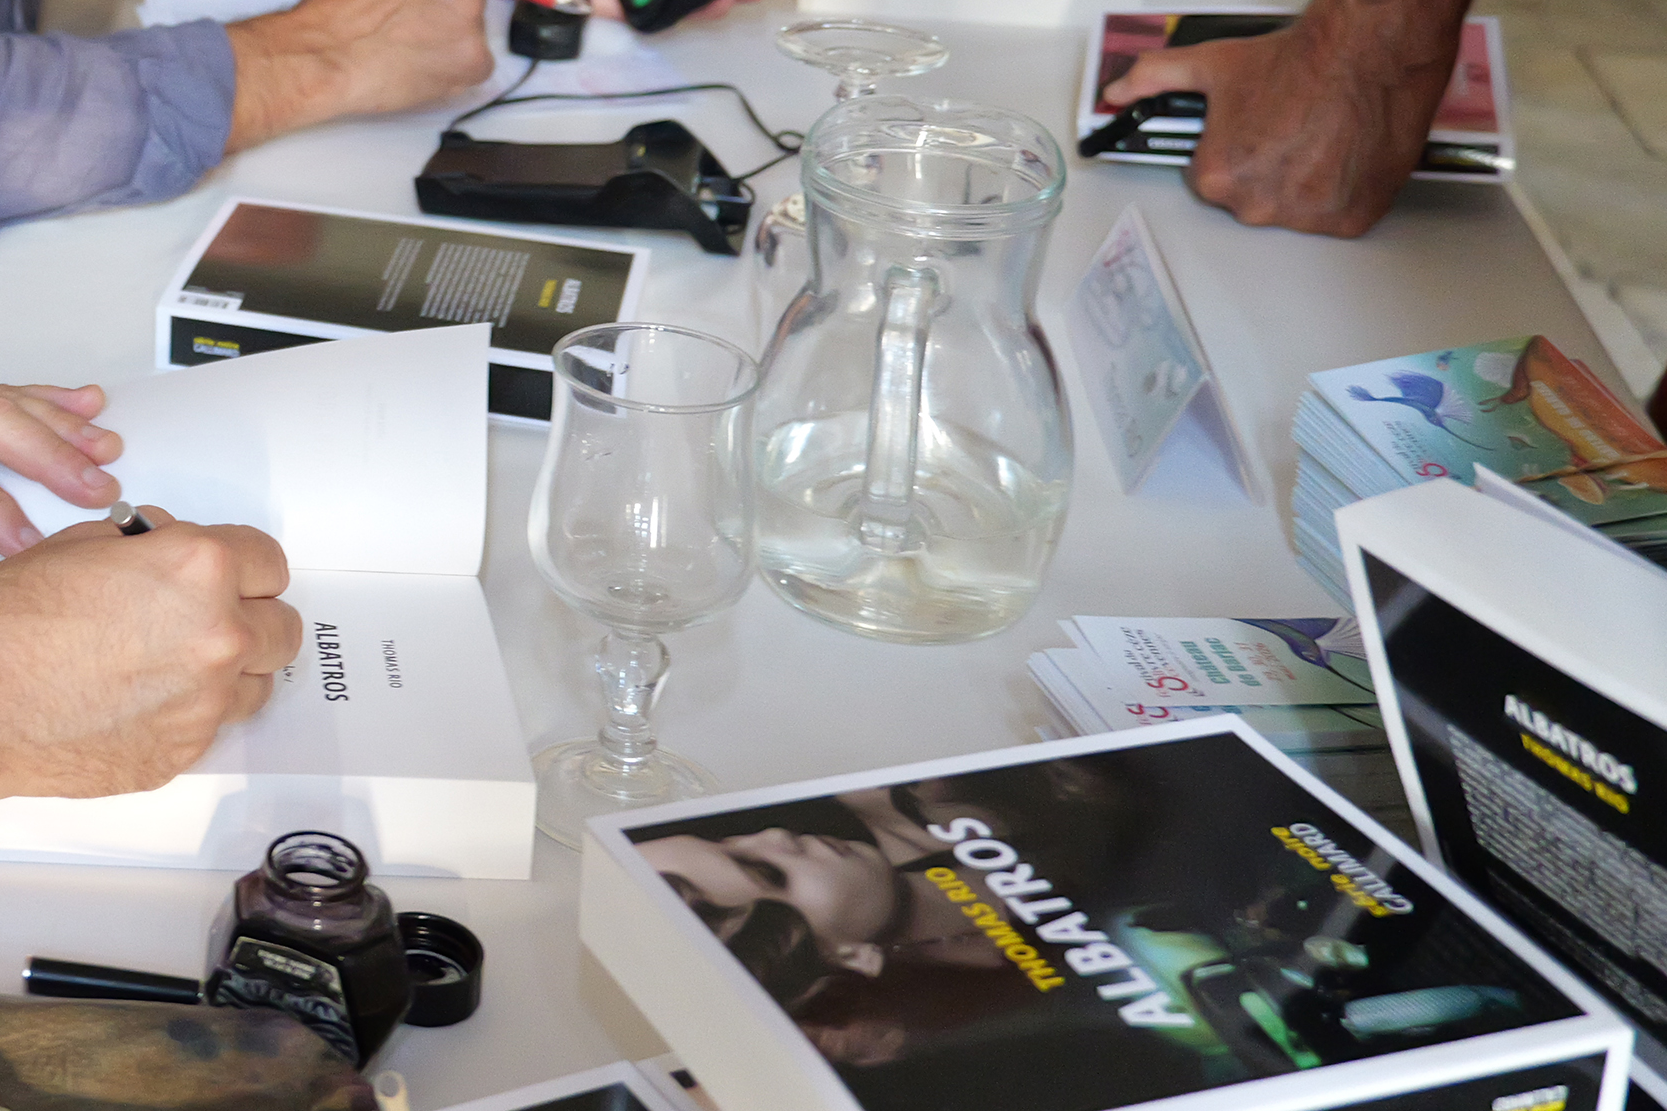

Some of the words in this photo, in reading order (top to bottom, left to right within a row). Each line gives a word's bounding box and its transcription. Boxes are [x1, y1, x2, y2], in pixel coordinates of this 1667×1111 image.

[314, 621, 350, 702] ALBATROS
[380, 639, 398, 673] THOMAS
[387, 674, 402, 688] RIO
[1504, 694, 1638, 795] ALBATROS
[925, 866, 977, 902] RIO
[926, 817, 1195, 1028] ALBATROS
[961, 902, 1065, 993] THOMAS
